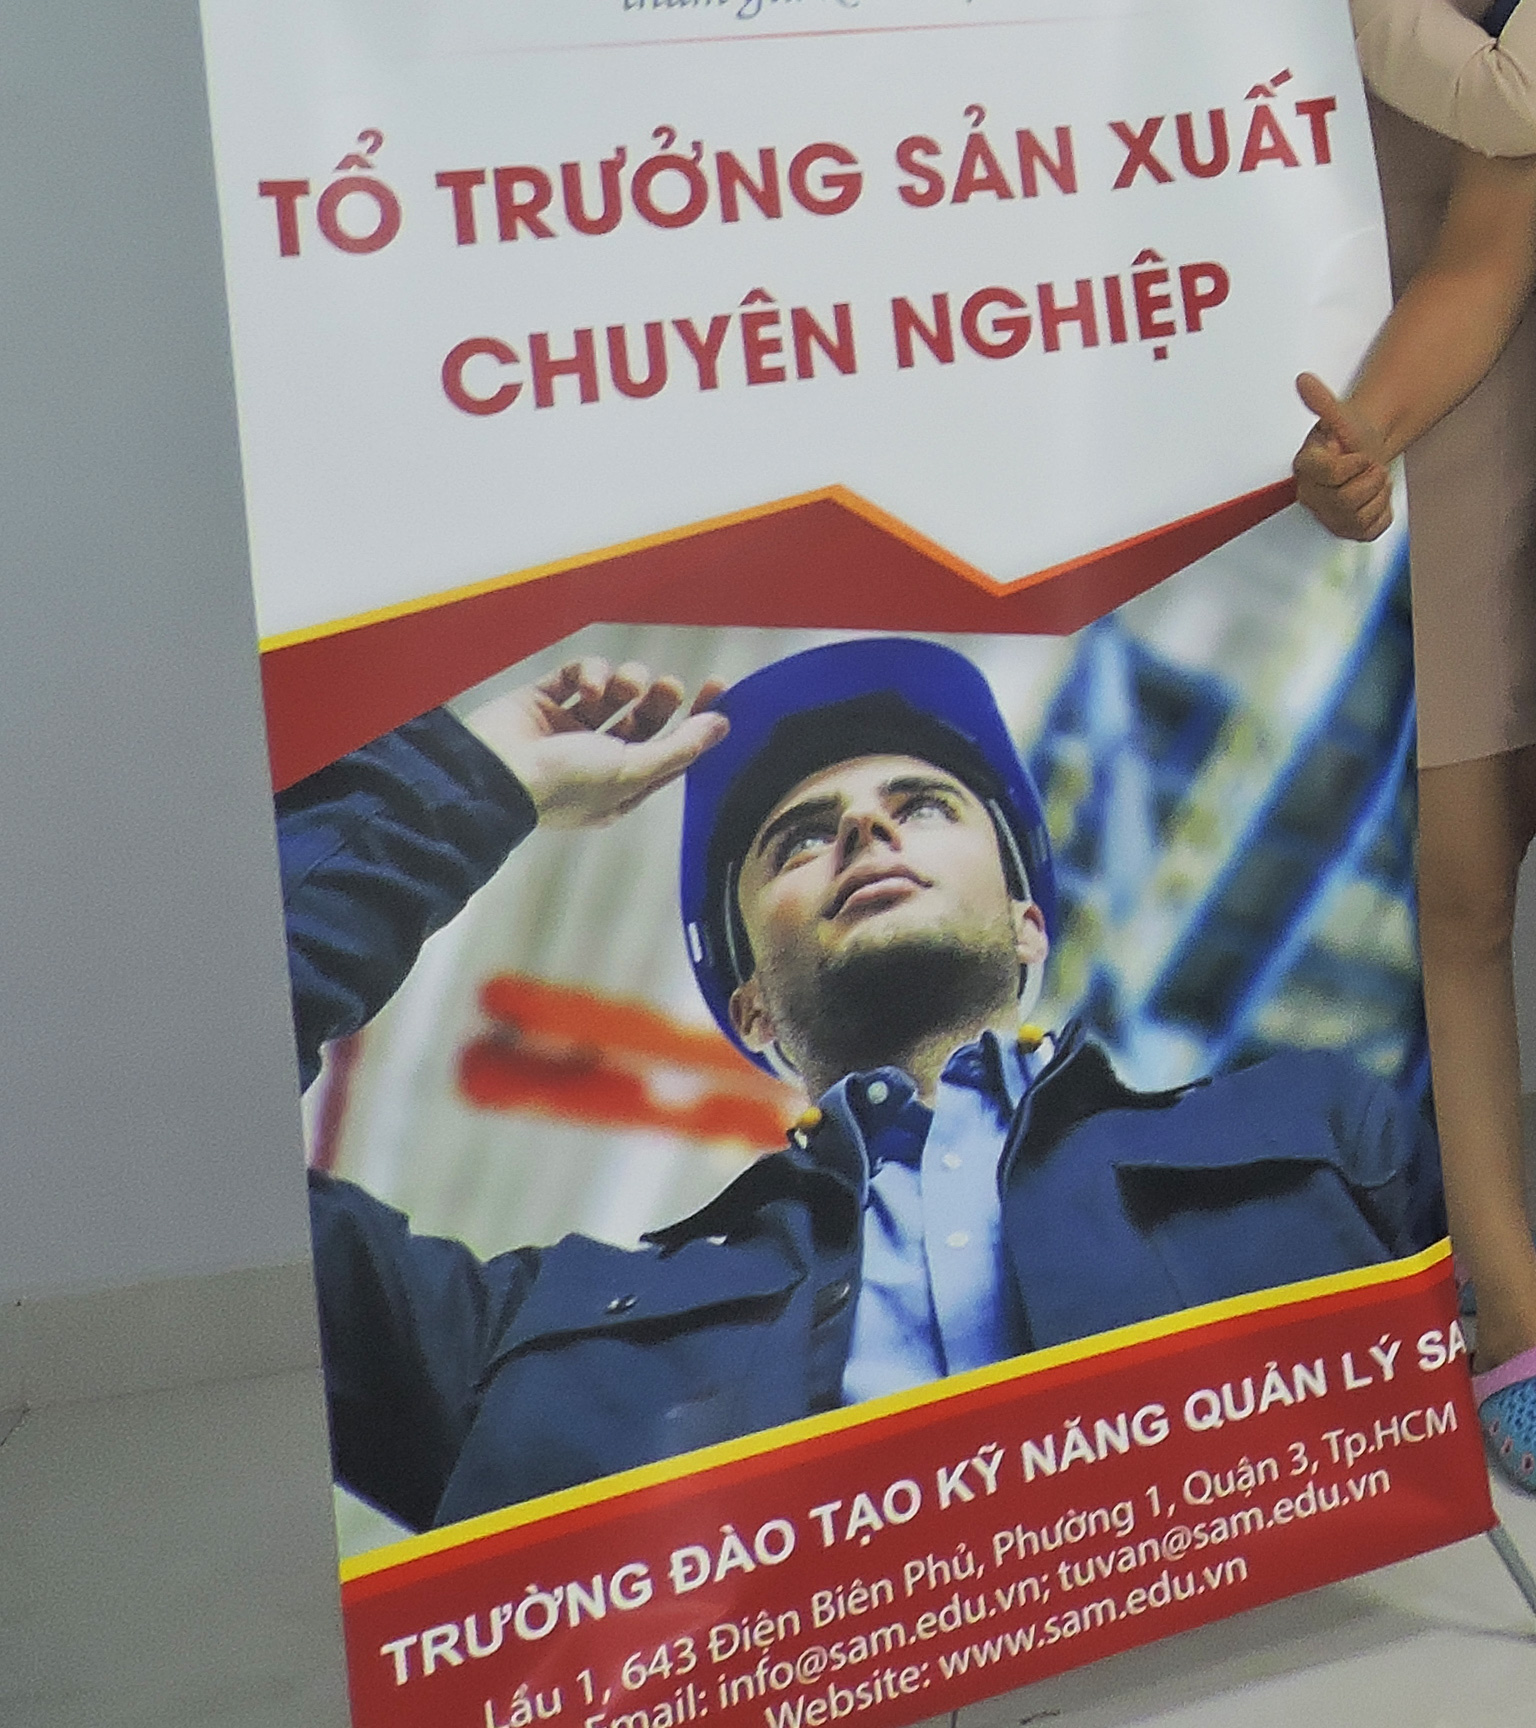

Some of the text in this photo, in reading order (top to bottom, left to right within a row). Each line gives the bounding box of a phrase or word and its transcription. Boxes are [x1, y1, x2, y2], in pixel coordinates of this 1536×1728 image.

[258, 68, 1338, 257] TỔ TRƯỞNG SẢN XUẤT
[440, 248, 1232, 417] CHUYÊN NGHIỆP
[380, 1319, 1468, 1686] TRƯỜNG ĐÀO TẠO KỸ NĂNG QUẢN LÝ SA
[576, 1668, 612, 1706] 1,
[621, 1635, 698, 1692] 643
[707, 1610, 801, 1664] Điện
[811, 1577, 896, 1630] Biên
[903, 1541, 985, 1600] Phủ,
[992, 1491, 1136, 1569] Phường
[1145, 1485, 1177, 1519] 1,
[1182, 1455, 1280, 1505] Quận
[1288, 1443, 1322, 1476] 3,
[1322, 1399, 1459, 1465] Tp.HCM
[585, 1466, 1392, 1728] Email: info@sam.edu.vn; tuvan@sam.edu.vn
[765, 1552, 1249, 1728] Website: www.sam.edu.vn
